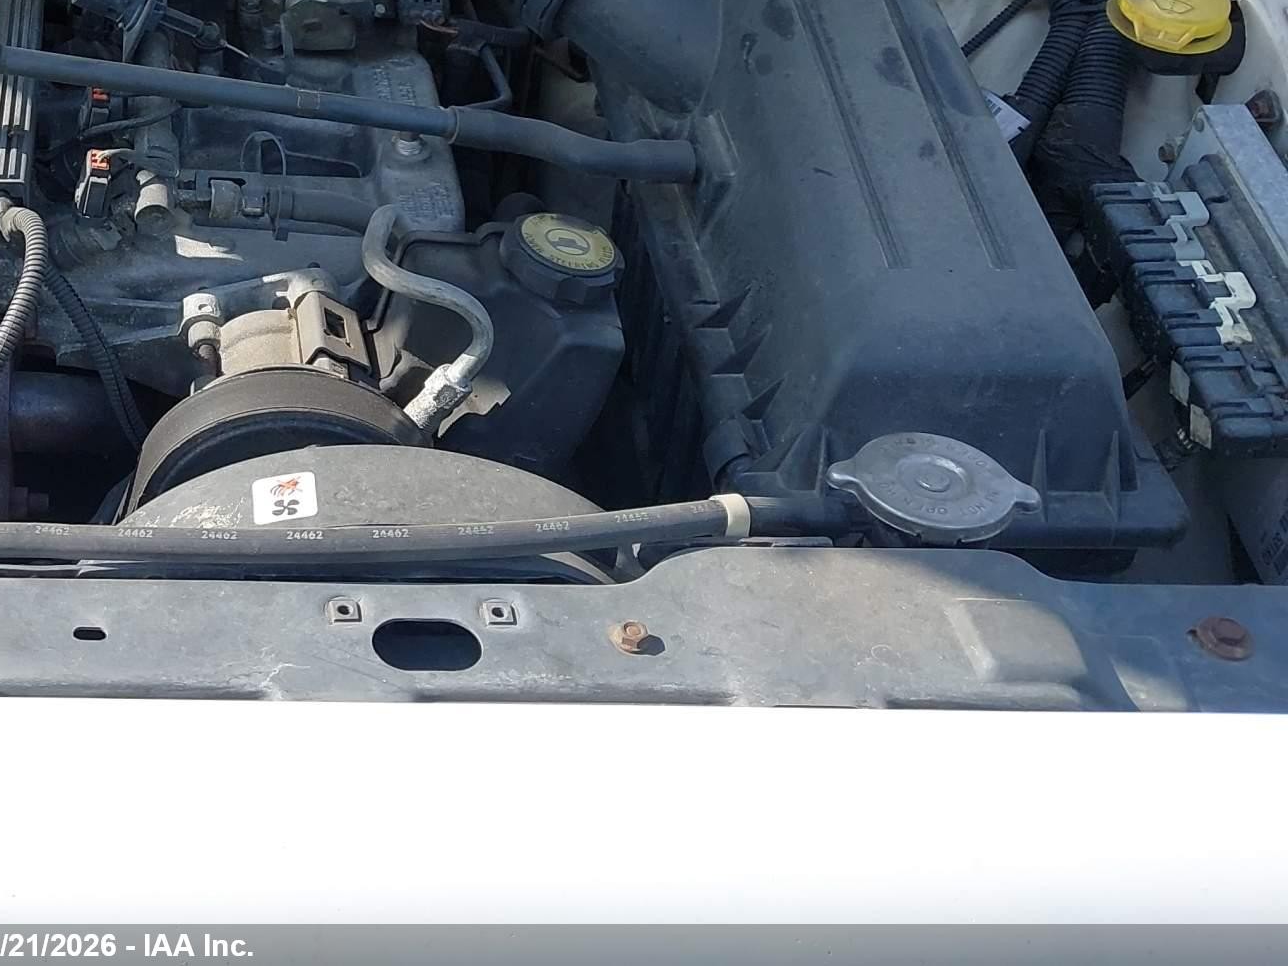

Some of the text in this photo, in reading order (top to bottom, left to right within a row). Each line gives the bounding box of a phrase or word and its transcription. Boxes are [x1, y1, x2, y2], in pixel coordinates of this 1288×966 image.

[118, 528, 153, 538] 24462
[286, 530, 323, 541] 24462
[373, 528, 409, 539] 24462
[535, 521, 571, 532] 24462
